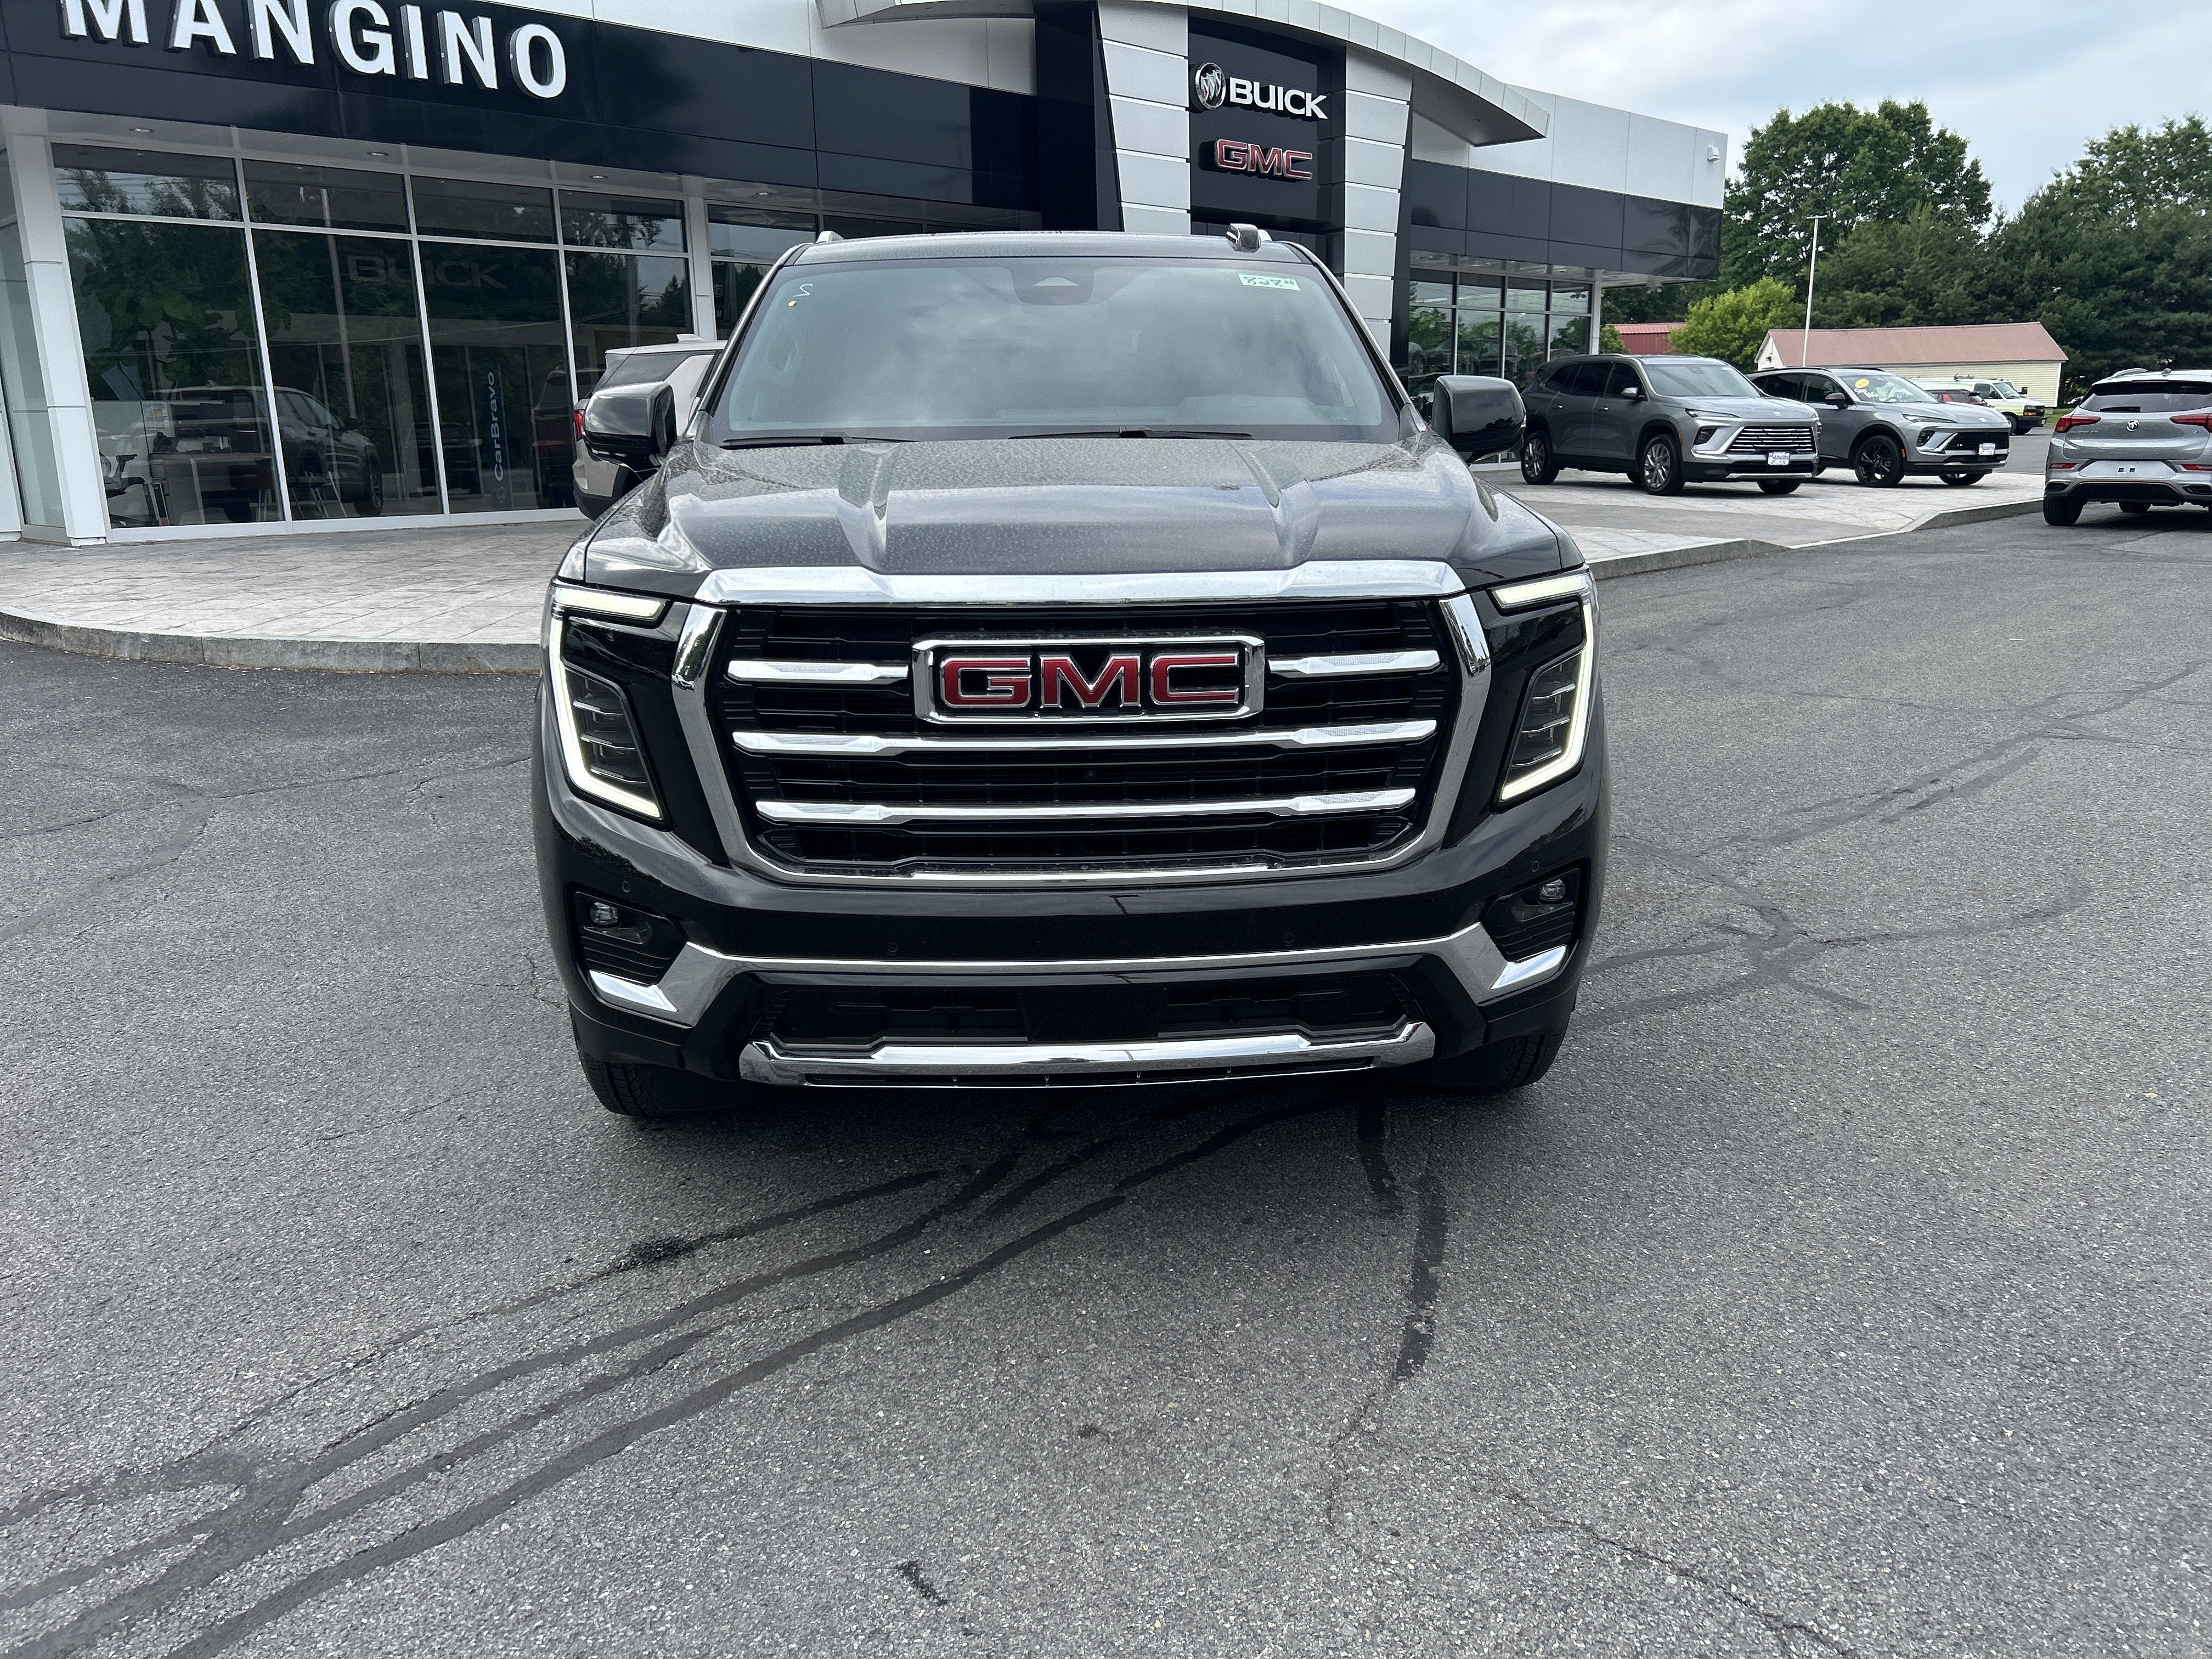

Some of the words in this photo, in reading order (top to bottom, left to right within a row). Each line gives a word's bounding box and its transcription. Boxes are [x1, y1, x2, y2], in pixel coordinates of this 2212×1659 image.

[60, 0, 566, 99] MANGINO
[1229, 77, 1328, 120] BUICK
[1215, 138, 1313, 180] GMC
[347, 255, 507, 289] BUICK
[488, 371, 504, 481] CarBravo
[940, 651, 1239, 709] GMC
